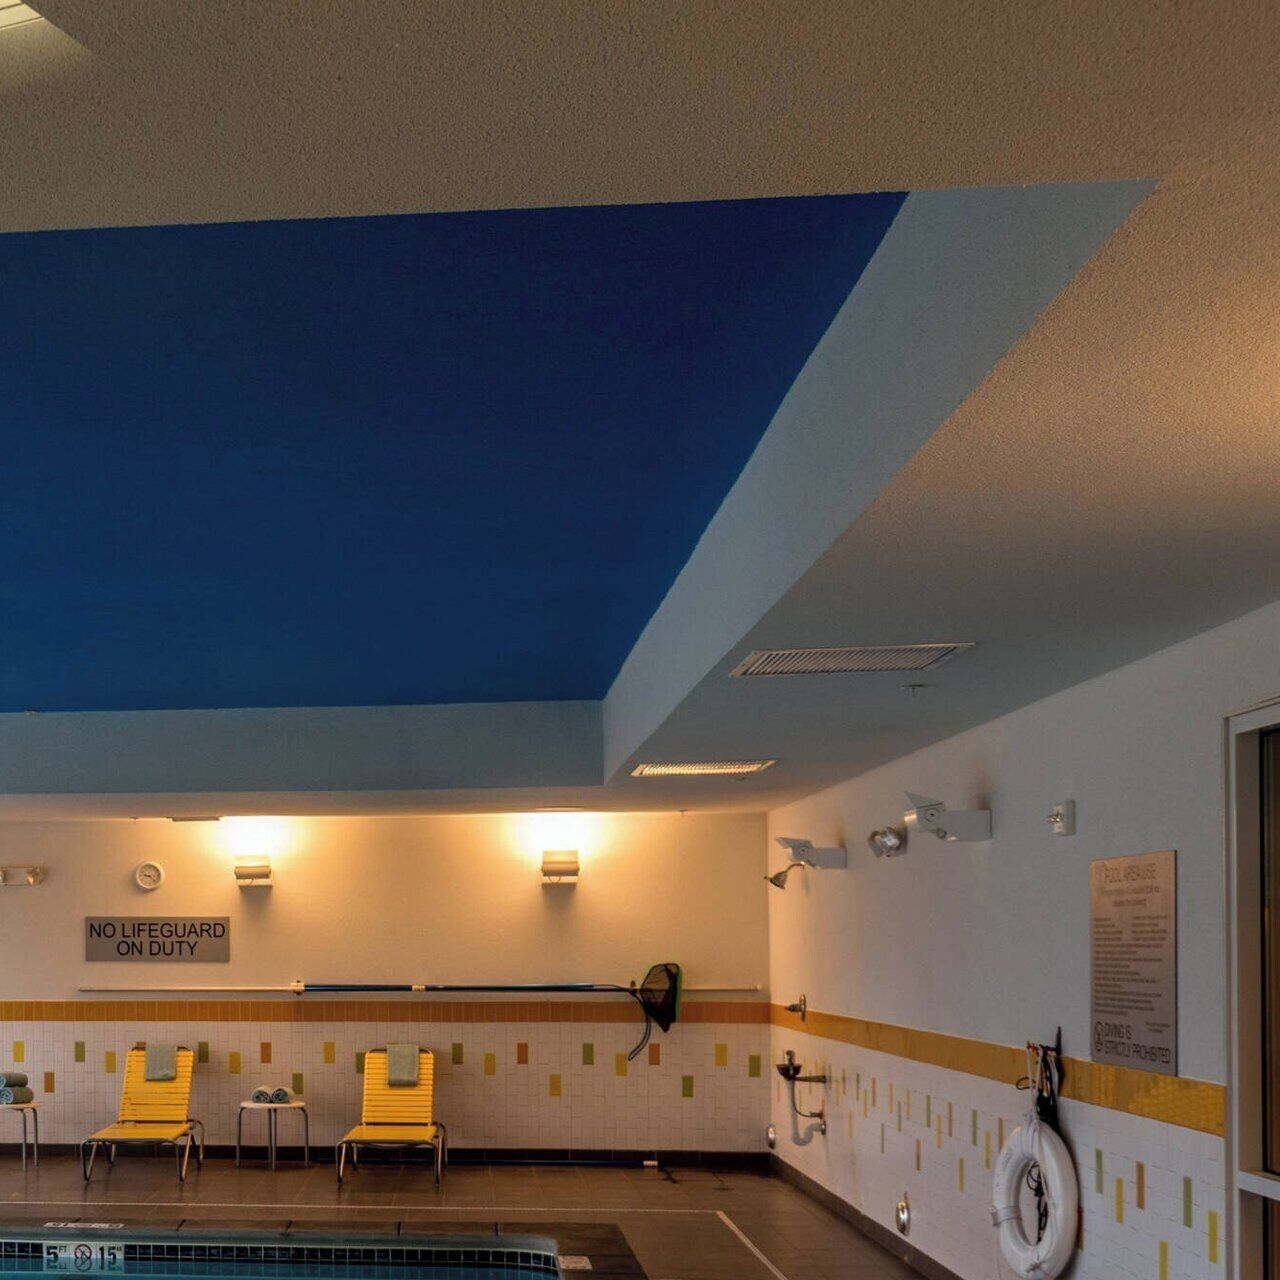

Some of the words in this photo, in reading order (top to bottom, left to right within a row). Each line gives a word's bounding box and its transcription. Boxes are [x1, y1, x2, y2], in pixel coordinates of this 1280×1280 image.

[89, 922, 117, 938] NO
[121, 922, 226, 938] LIFEGUARD
[116, 940, 143, 956] ON
[149, 940, 199, 956] DUTY
